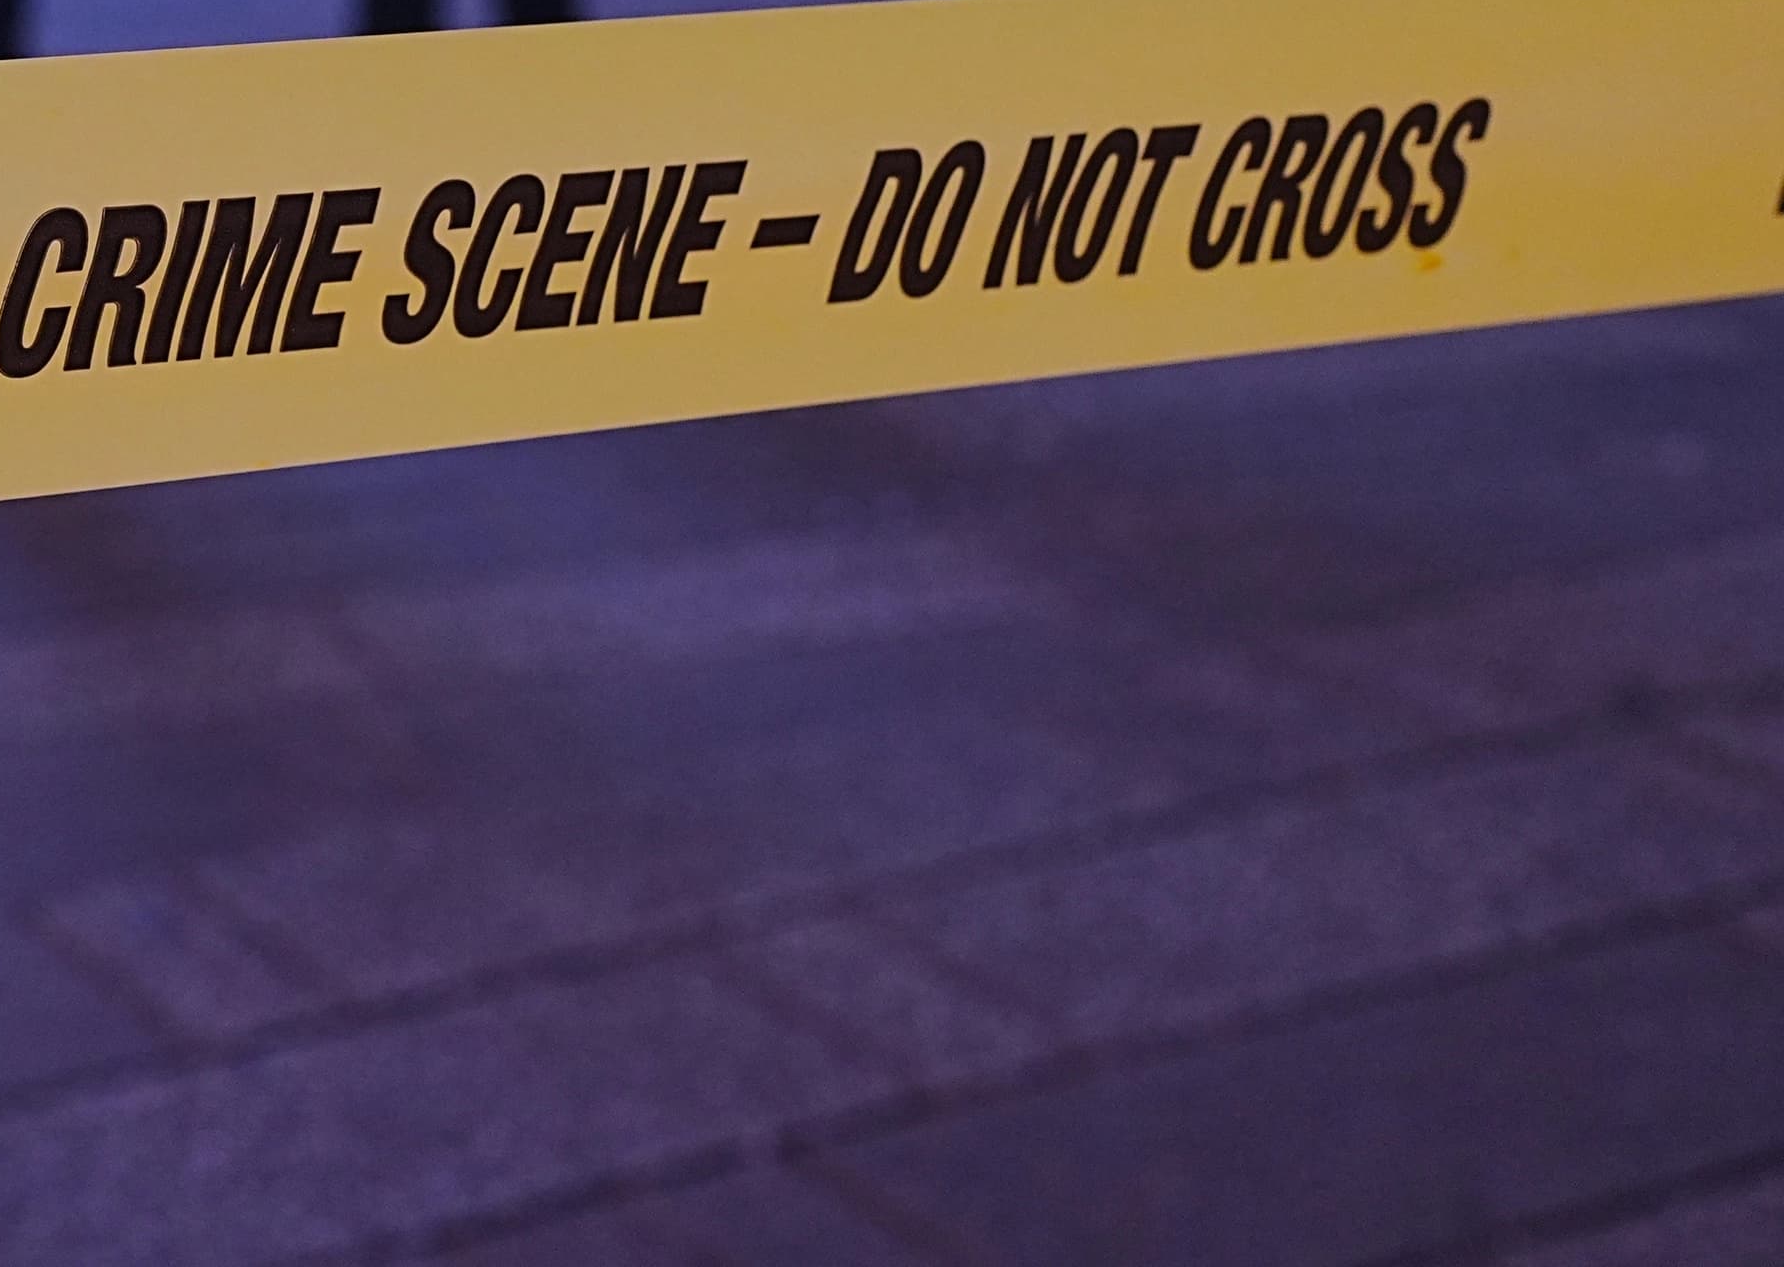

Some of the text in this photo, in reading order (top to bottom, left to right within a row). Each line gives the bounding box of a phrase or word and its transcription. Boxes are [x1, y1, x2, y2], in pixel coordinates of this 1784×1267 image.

[381, 158, 749, 346] SCENE
[826, 139, 987, 305] DO
[982, 122, 1202, 290] NOT
[1188, 97, 1492, 272] CROSS
